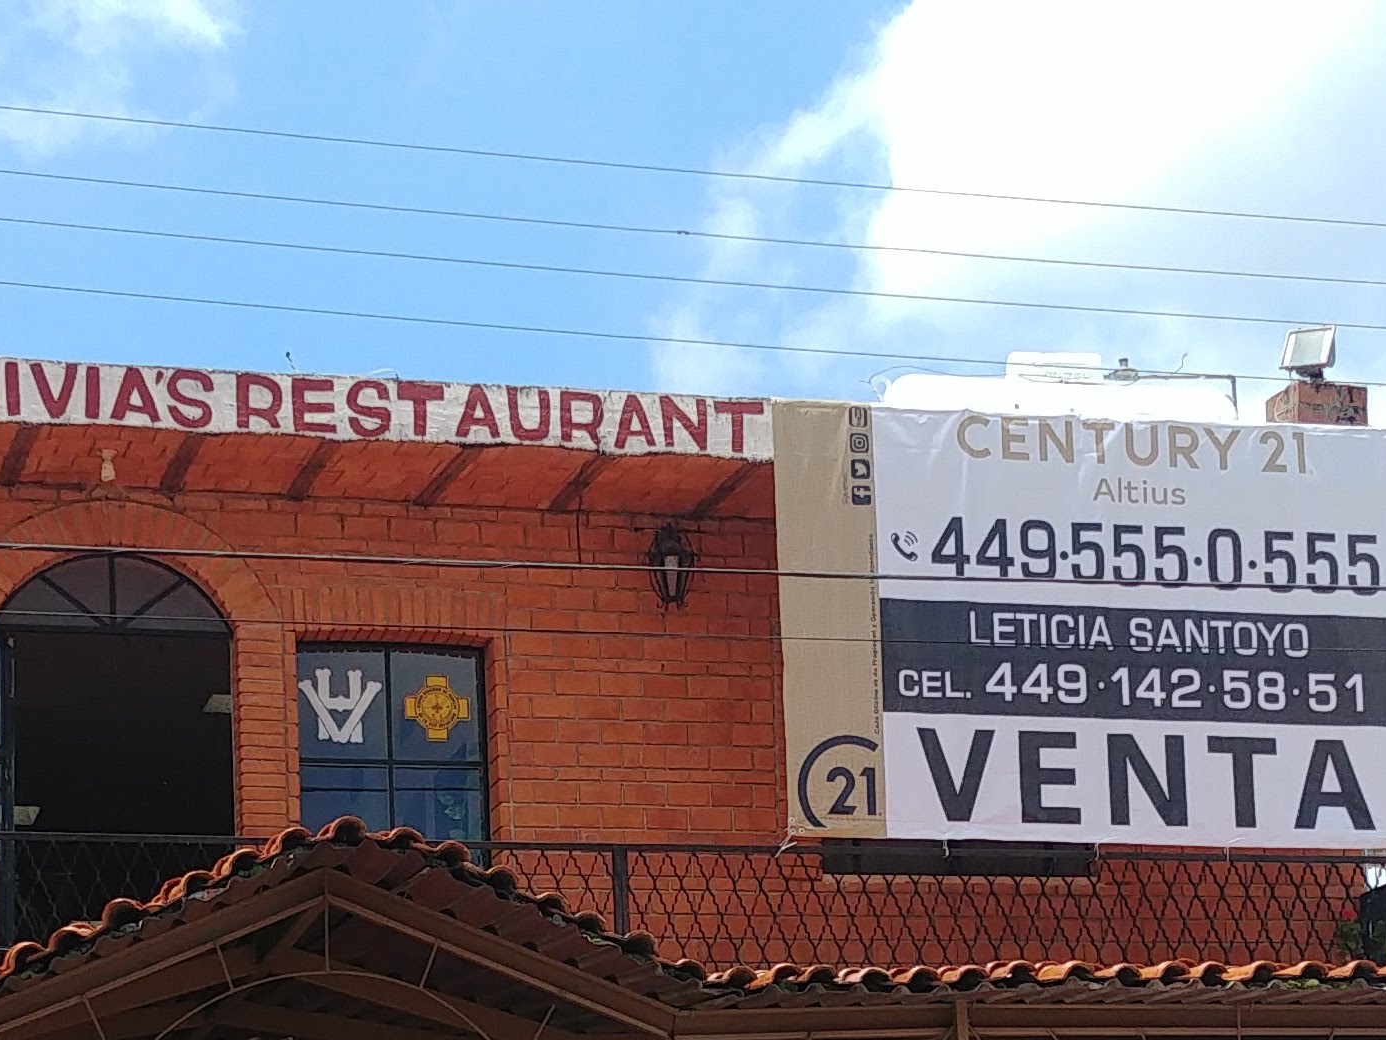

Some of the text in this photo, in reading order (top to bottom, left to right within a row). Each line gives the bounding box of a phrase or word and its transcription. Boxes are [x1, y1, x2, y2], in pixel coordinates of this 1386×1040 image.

[235, 373, 764, 454] RESTAURANT
[956, 414, 1310, 475] CENTURY 21
[1093, 478, 1187, 507] Altius
[968, 609, 1311, 659] LETICIA SANTOYO
[898, 668, 972, 700] CEL.
[915, 726, 1378, 832] VENTA
